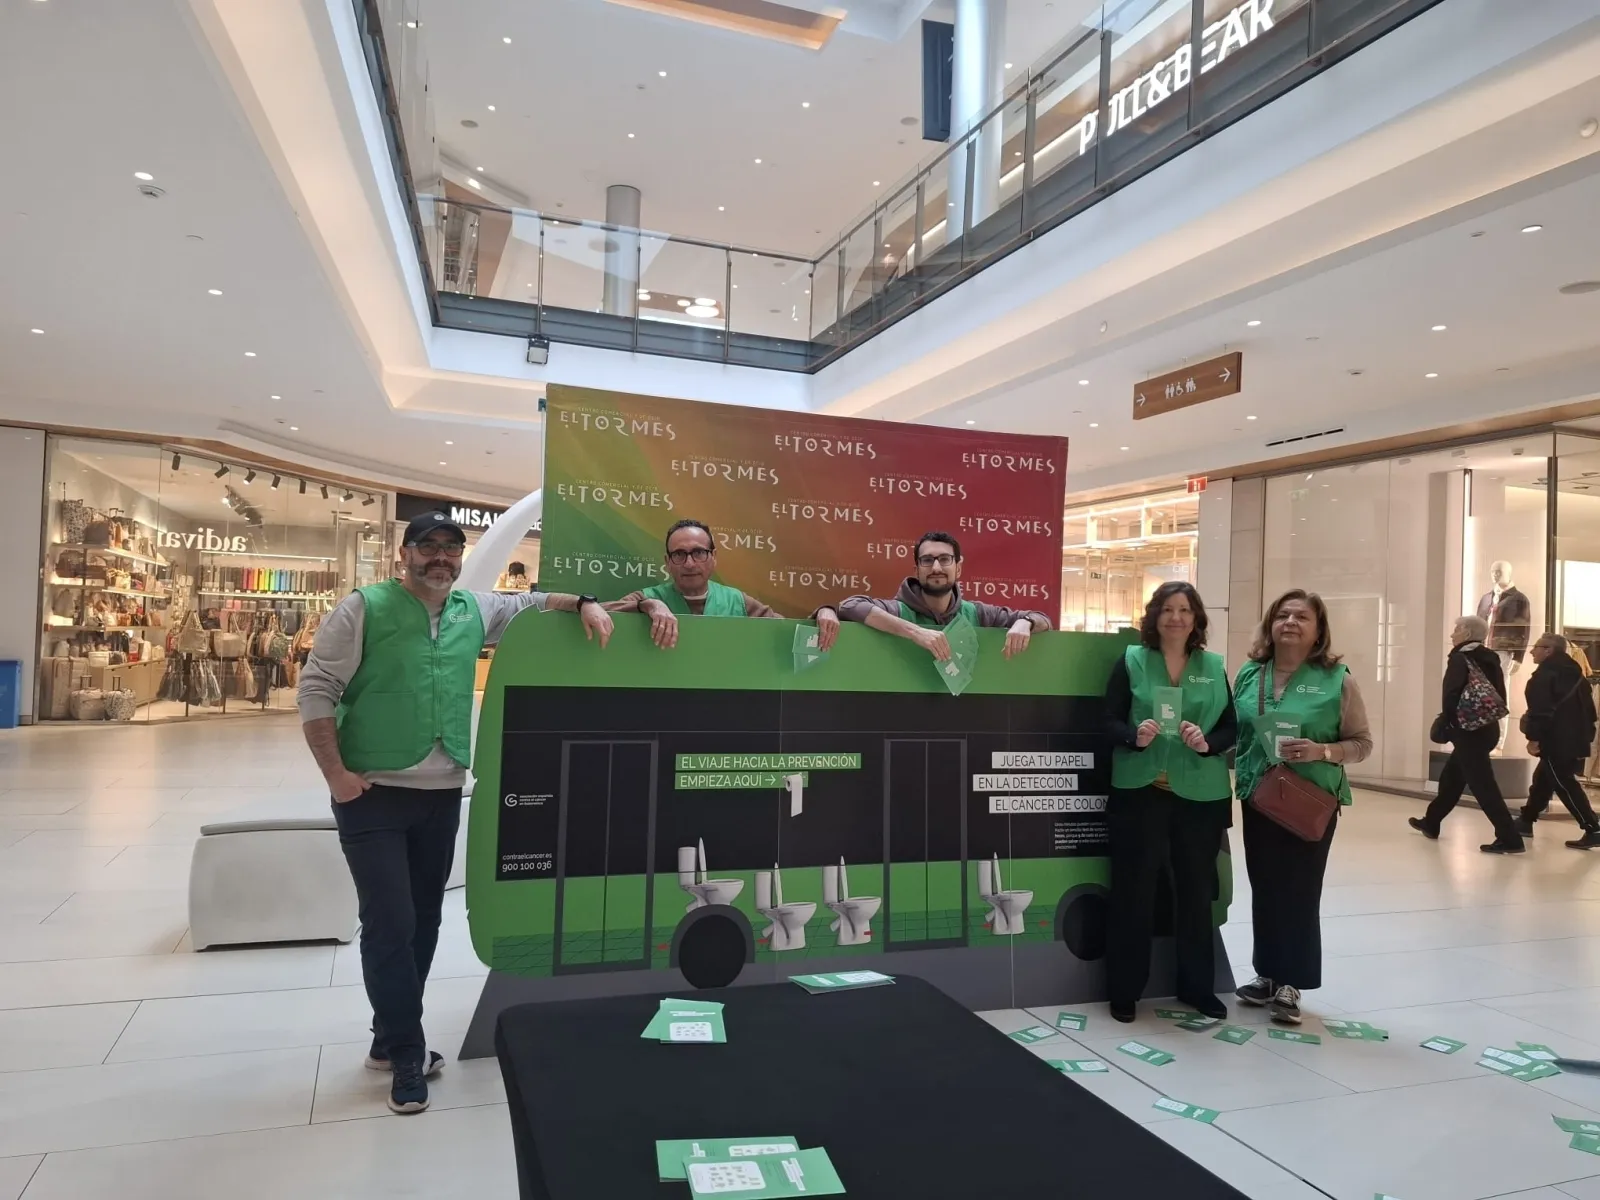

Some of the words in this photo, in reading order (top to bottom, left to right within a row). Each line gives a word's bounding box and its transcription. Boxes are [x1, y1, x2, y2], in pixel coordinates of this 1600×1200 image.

[681, 756, 696, 769] EL
[698, 756, 731, 769] VIAJE
[733, 756, 769, 768] HACIA
[771, 756, 786, 768] LA
[788, 753, 857, 768] PREVENCIÓN
[1000, 755, 1036, 767] JUEGA
[1039, 755, 1052, 767] TU
[1055, 755, 1087, 767] PAPEL
[680, 774, 732, 787] EMPIEZA
[733, 772, 762, 787] AQUÍ
[978, 777, 993, 789] EN
[996, 777, 1010, 789] LA
[1012, 774, 1073, 789] DETECCIÓN
[995, 799, 1009, 811] EL
[1011, 796, 1055, 811] CÁNCER
[1058, 798, 1071, 810] DE
[502, 863, 518, 872] 900
[520, 862, 535, 870] 100
[536, 860, 552, 871] 036
